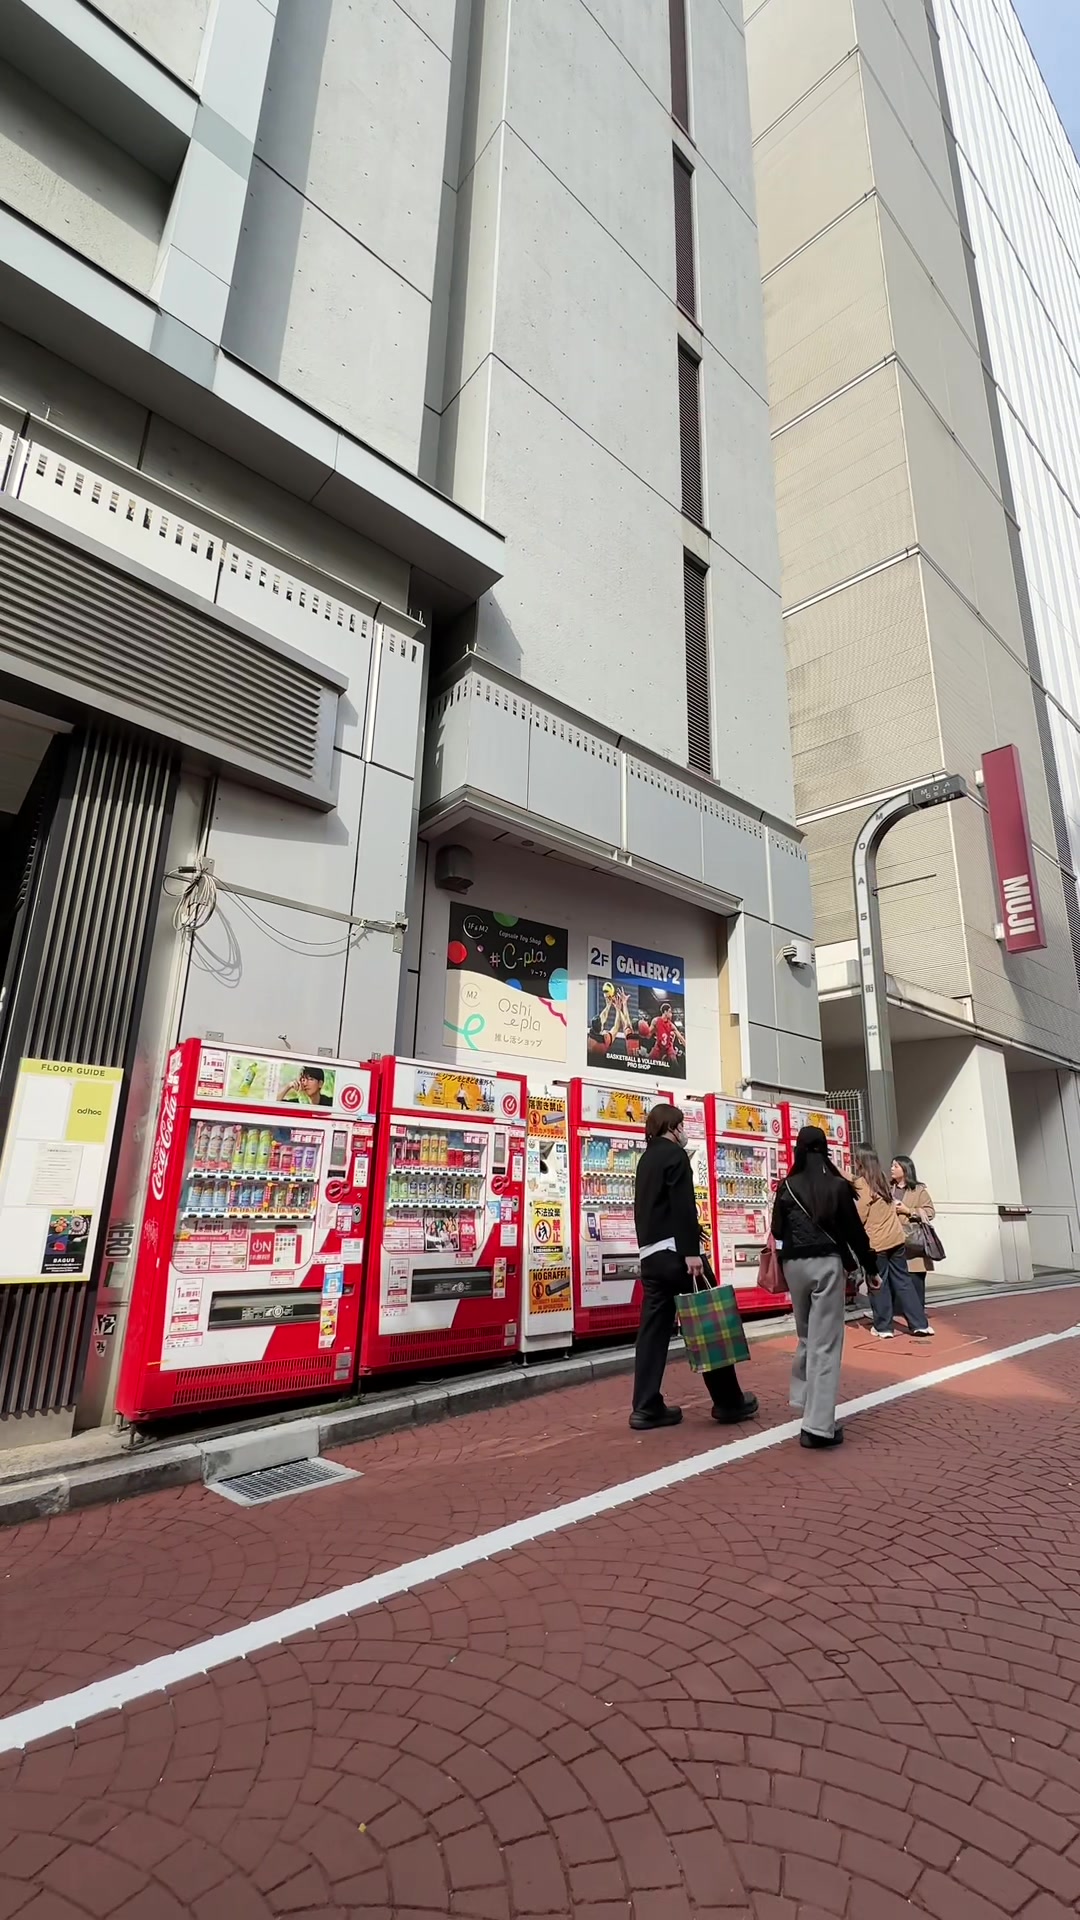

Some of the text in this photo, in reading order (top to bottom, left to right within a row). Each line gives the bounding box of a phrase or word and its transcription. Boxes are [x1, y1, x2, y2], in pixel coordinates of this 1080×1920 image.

[1002, 874, 1036, 936] MUJI
[499, 930, 542, 946] Capsule Toy Shop
[590, 947, 609, 967] 2F
[466, 990, 478, 999] M2
[498, 998, 531, 1016] Oshi
[494, 1033, 543, 1048] 推し活ショップ
[606, 1052, 637, 1063] BASKETBALL
[641, 1057, 670, 1068] VOLLEYBALL
[41, 1063, 106, 1077] FLOOR GUIDE
[528, 1099, 563, 1112] 落書き禁止
[152, 1089, 177, 1200] Coca-Cola
[534, 1207, 561, 1217] 不法投棄
[552, 1219, 561, 1243] 禁止
[533, 1271, 542, 1281] NO
